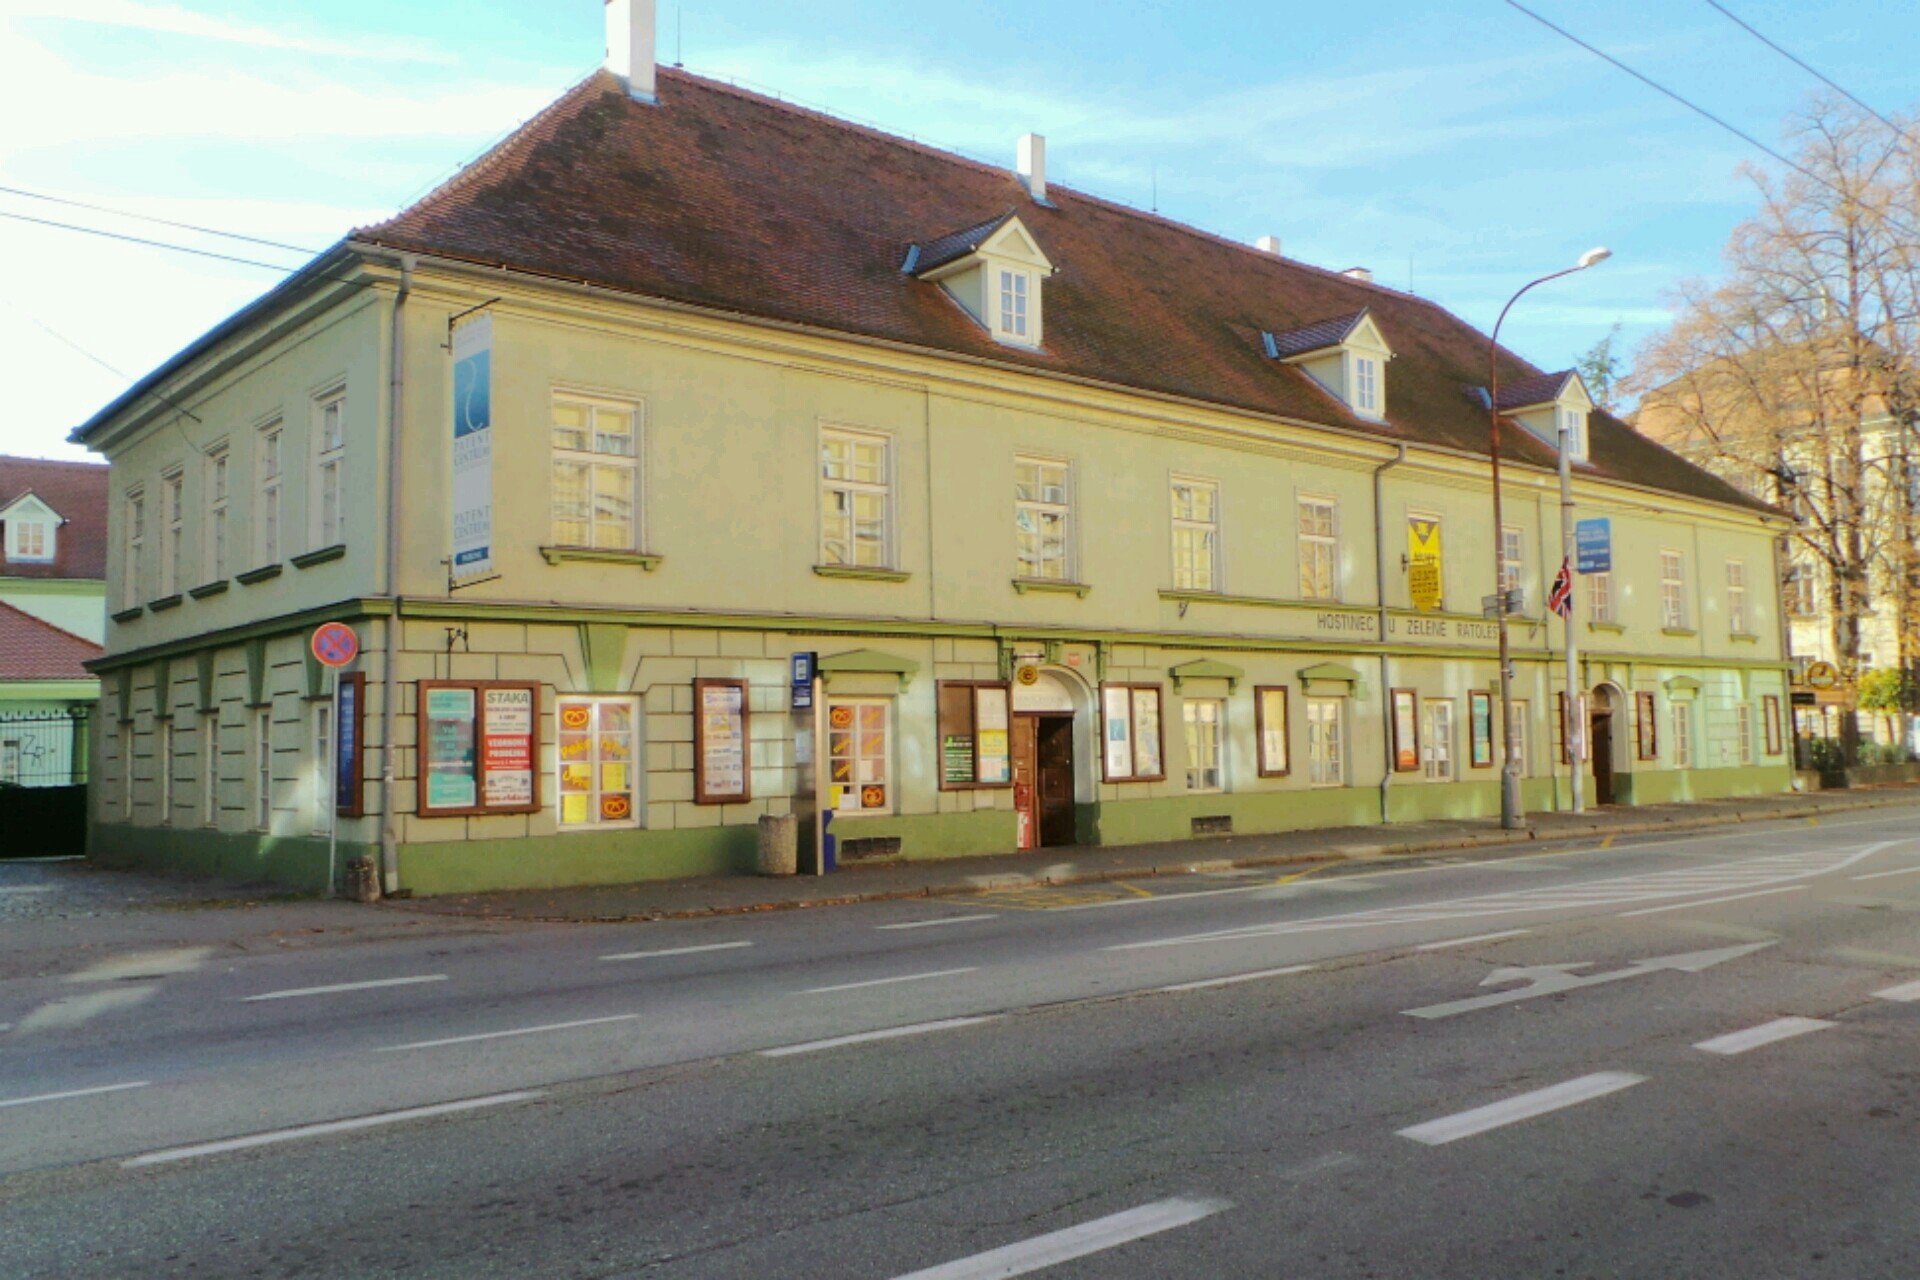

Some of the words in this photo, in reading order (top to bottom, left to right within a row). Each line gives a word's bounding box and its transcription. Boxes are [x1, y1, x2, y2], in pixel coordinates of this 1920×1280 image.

[1316, 613, 1374, 632] HOSTINEC
[1388, 618, 1396, 633] U
[487, 692, 529, 704] STAKA
